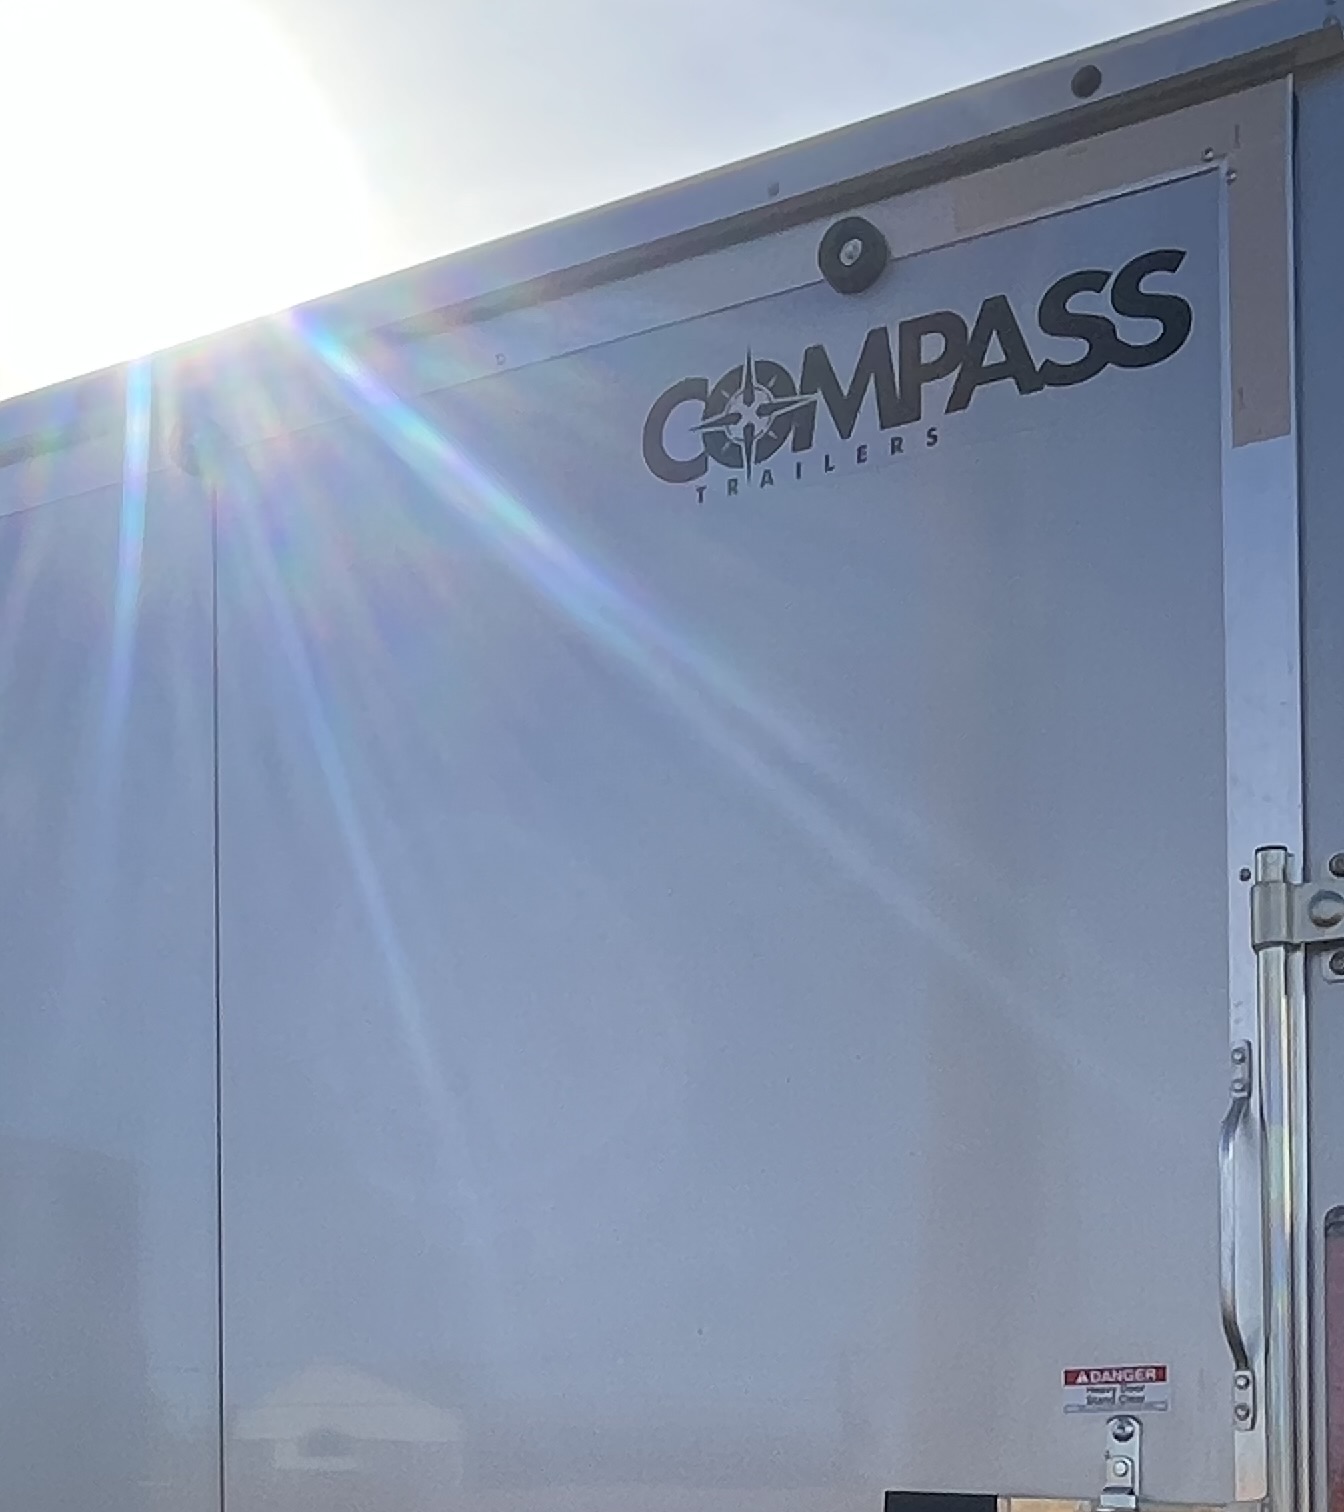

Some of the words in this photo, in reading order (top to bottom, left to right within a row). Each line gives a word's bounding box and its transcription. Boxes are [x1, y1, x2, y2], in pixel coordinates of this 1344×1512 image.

[643, 249, 1193, 484] COMPASS
[695, 426, 939, 504] TRAILERS
[1090, 1368, 1156, 1382] DANGER
